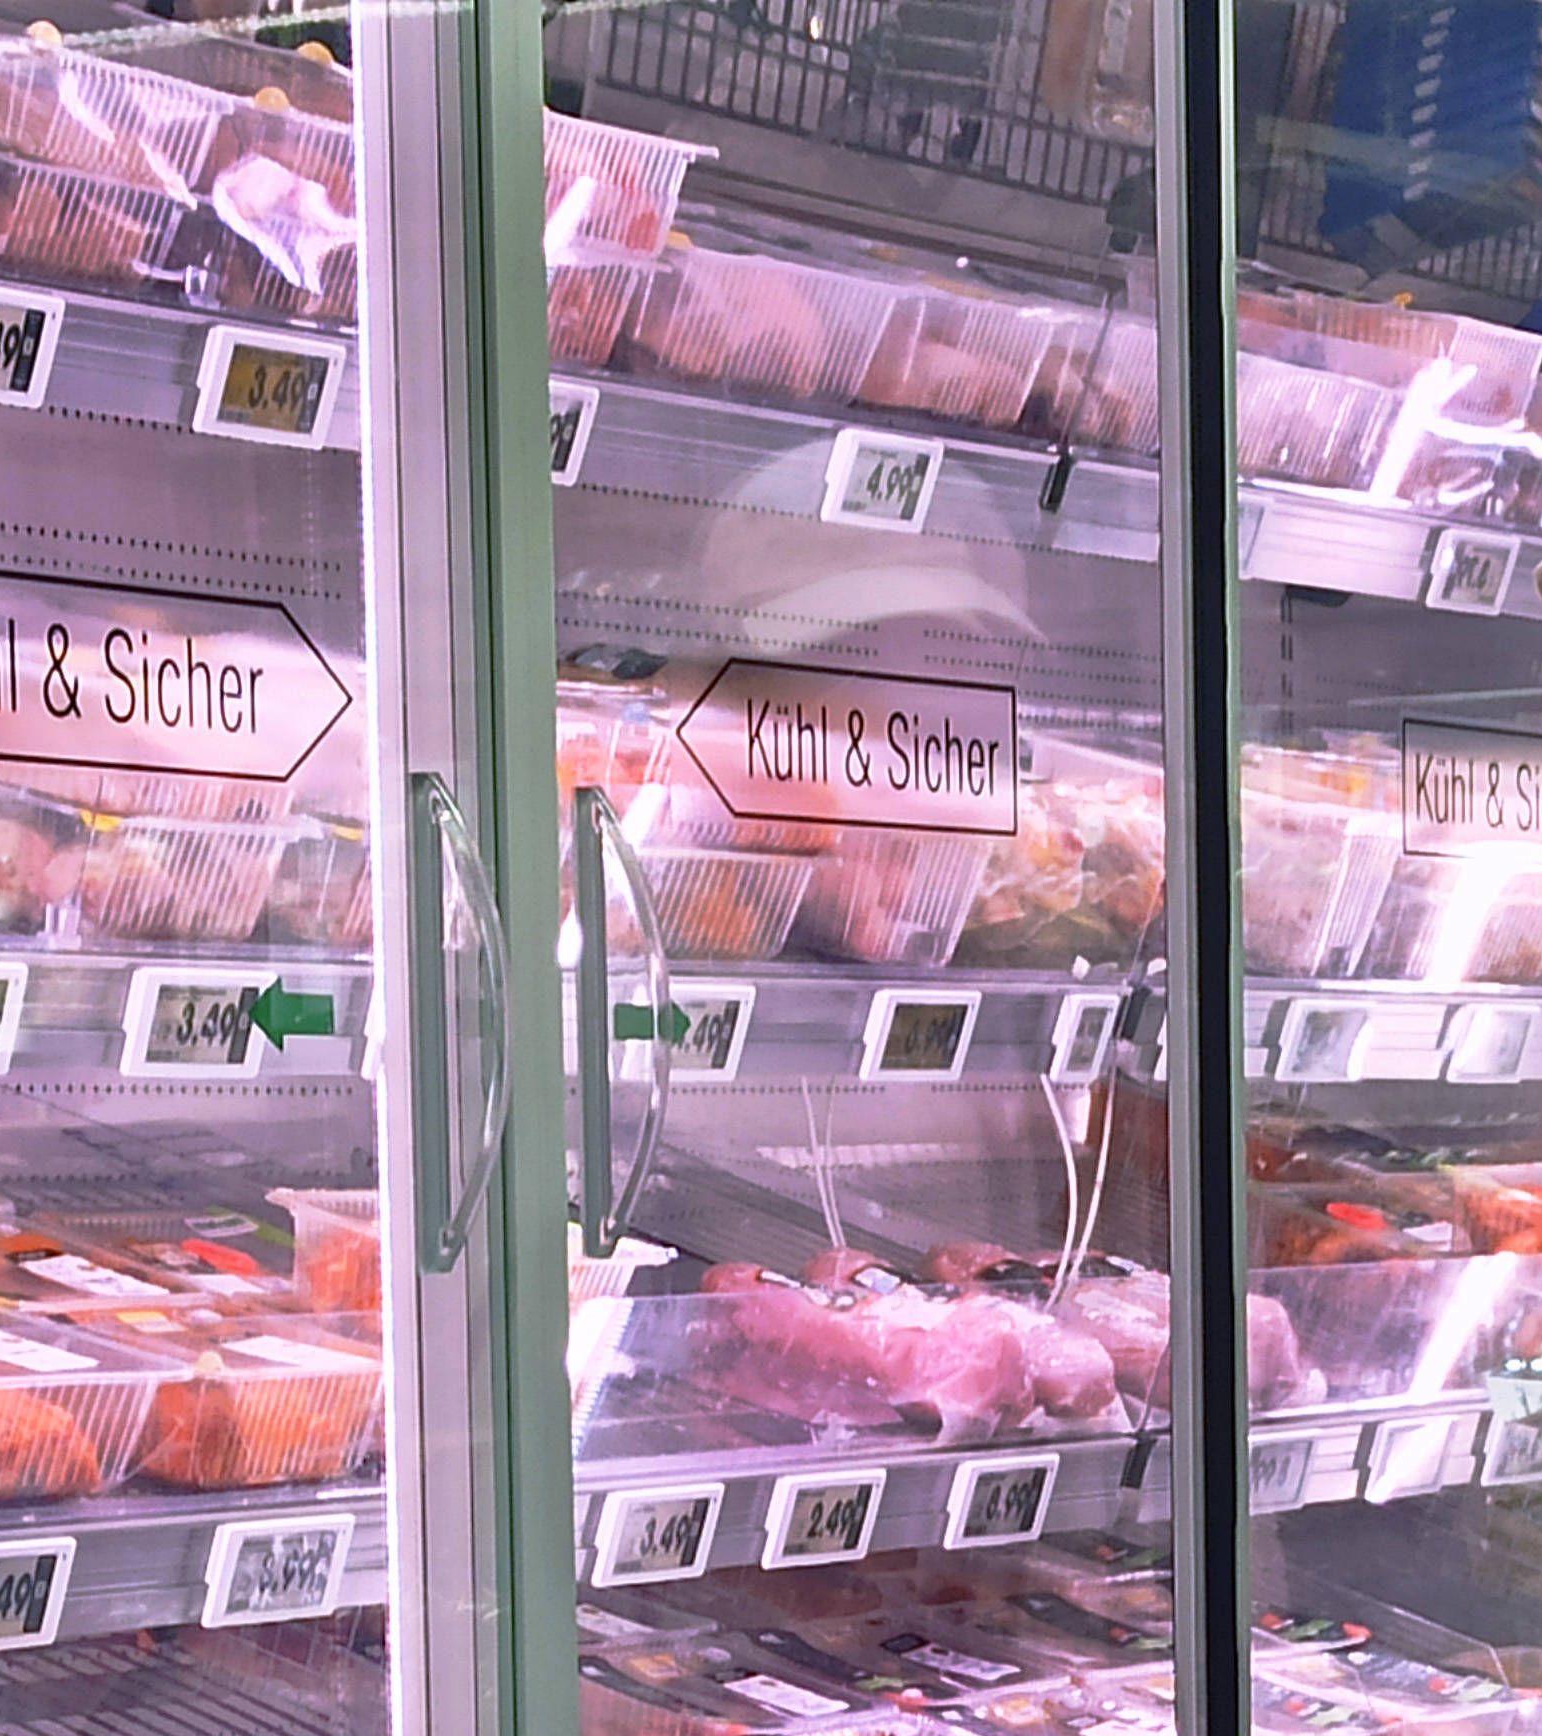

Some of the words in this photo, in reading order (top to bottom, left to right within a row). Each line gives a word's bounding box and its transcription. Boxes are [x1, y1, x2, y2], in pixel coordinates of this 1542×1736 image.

[247, 364, 307, 412] 3.49
[867, 461, 914, 503] 4.99
[42, 622, 82, 720] &
[103, 626, 264, 735] Sicher
[747, 698, 828, 785] Kühl
[845, 708, 872, 787] &
[887, 710, 999, 797] Sicher
[1415, 752, 1474, 824] Kühl
[1485, 761, 1505, 828] &
[176, 1002, 238, 1046] 3.49
[672, 1013, 721, 1053] .49
[639, 1511, 689, 1556] 3.49
[807, 1499, 857, 1538] 2.49
